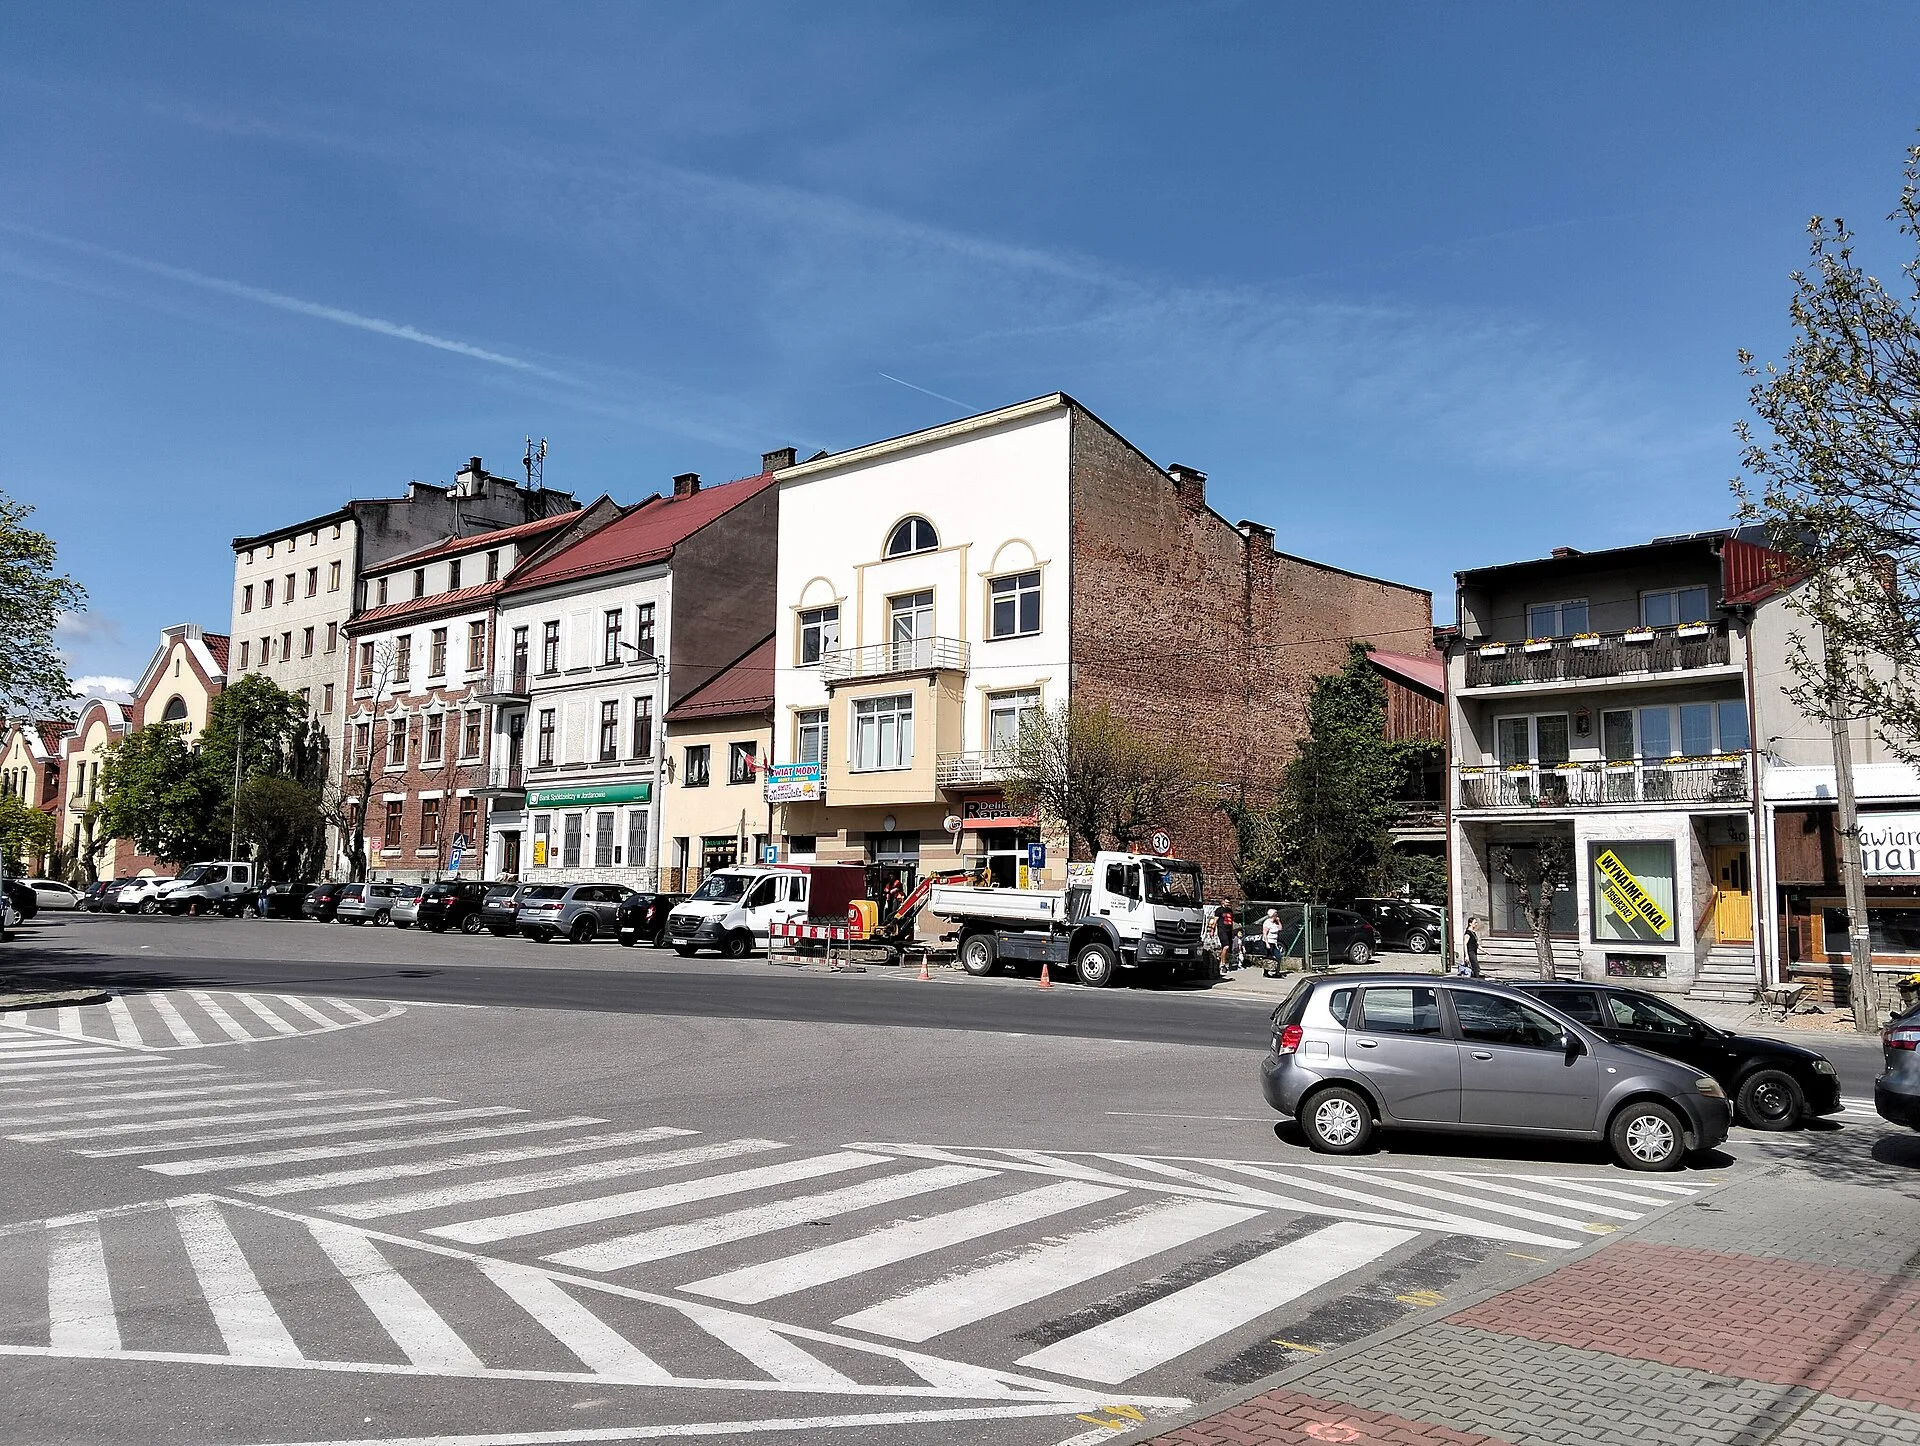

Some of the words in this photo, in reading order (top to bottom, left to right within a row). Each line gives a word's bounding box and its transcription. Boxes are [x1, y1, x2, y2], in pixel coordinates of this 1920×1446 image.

[795, 765, 818, 776] MODY
[964, 801, 1012, 821] Rapa
[1154, 836, 1169, 849] 30
[1859, 826, 1920, 847] awiar
[766, 847, 775, 864] P
[1031, 846, 1042, 866] P
[1601, 855, 1644, 904] WYNAJMĘ
[1636, 898, 1667, 931] LOKAL
